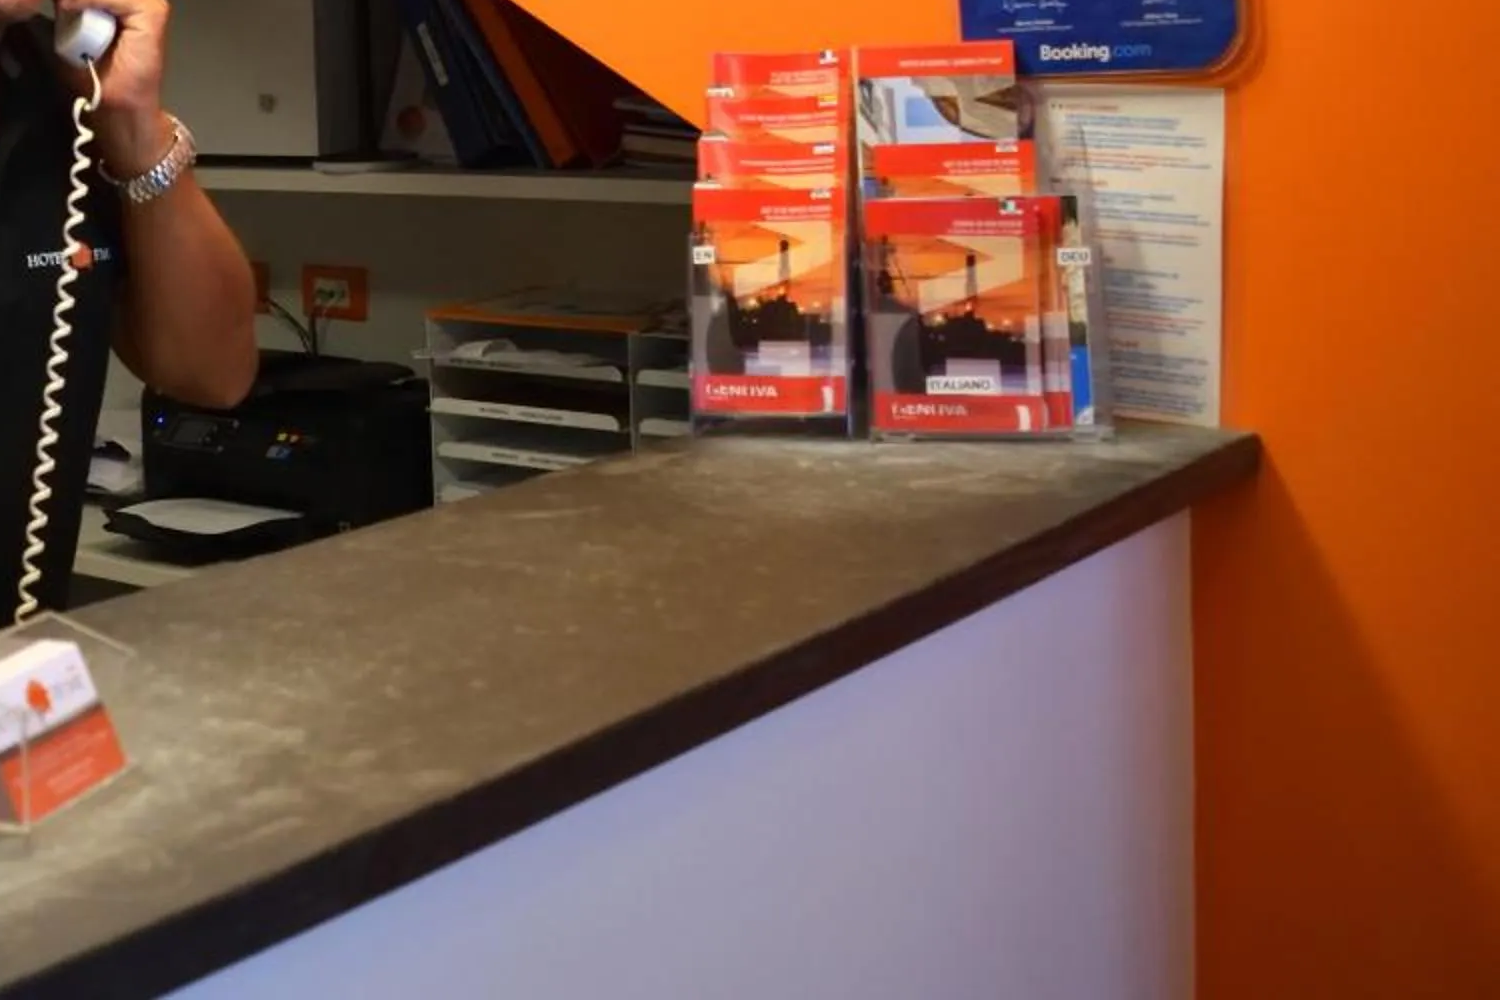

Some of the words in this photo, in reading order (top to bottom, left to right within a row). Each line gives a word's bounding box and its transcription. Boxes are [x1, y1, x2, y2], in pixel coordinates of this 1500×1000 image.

[1039, 41, 1153, 63] Booking.com
[26, 251, 63, 269] HOTE
[930, 380, 991, 392] ITALIANO
